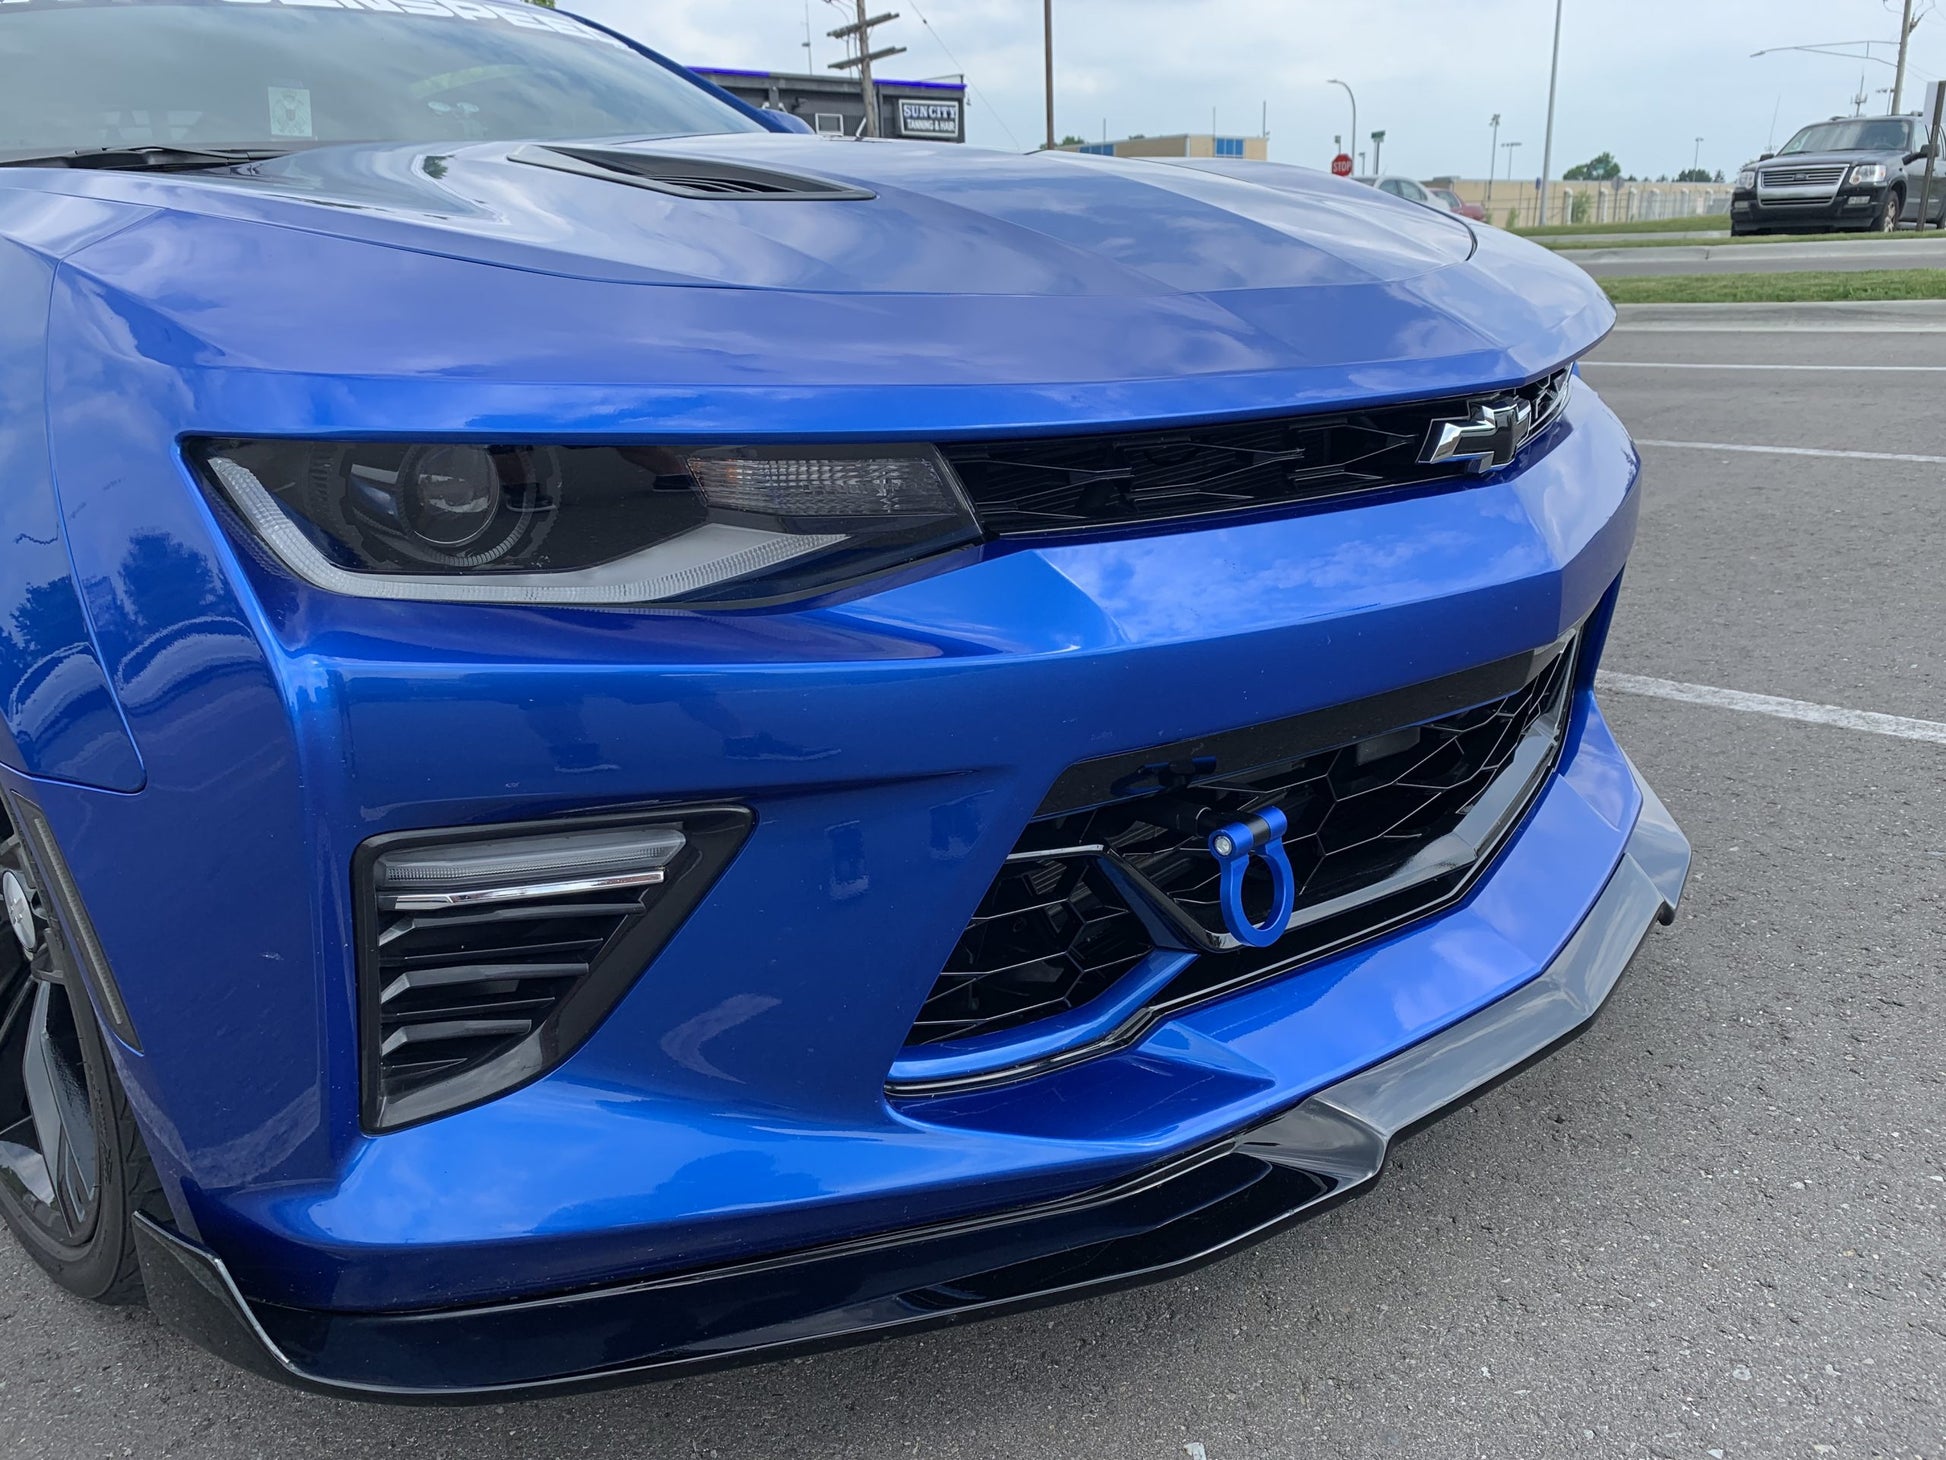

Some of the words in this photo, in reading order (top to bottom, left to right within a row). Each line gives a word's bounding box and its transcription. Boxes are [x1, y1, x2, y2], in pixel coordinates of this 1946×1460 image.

[903, 105, 927, 117] SUN
[928, 106, 956, 118] CITY
[907, 118, 933, 130] TANNING
[934, 120, 939, 131] &
[940, 120, 955, 131] HAIR
[1333, 161, 1351, 172] STOP
